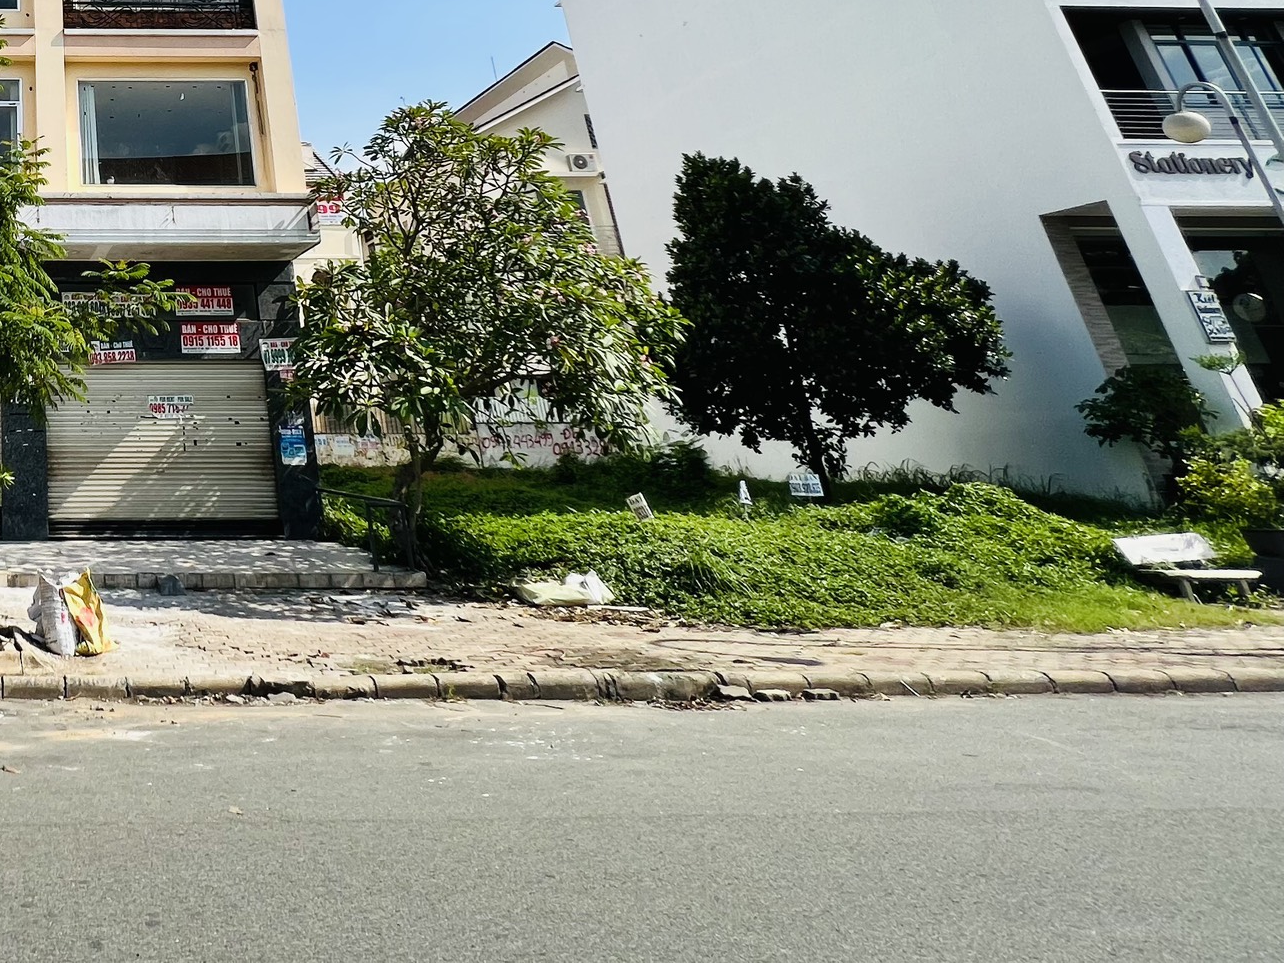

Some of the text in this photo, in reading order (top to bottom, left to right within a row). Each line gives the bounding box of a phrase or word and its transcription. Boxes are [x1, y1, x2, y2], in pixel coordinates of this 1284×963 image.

[1128, 150, 1254, 179] Stationery
[197, 288, 211, 296] CHO
[213, 287, 232, 296] THUÊ
[200, 298, 215, 309] 441
[181, 323, 196, 334] BÁN
[203, 324, 218, 334] CHO
[219, 322, 238, 334] THUÊ
[183, 335, 204, 347] 0915
[206, 335, 226, 347] 1155
